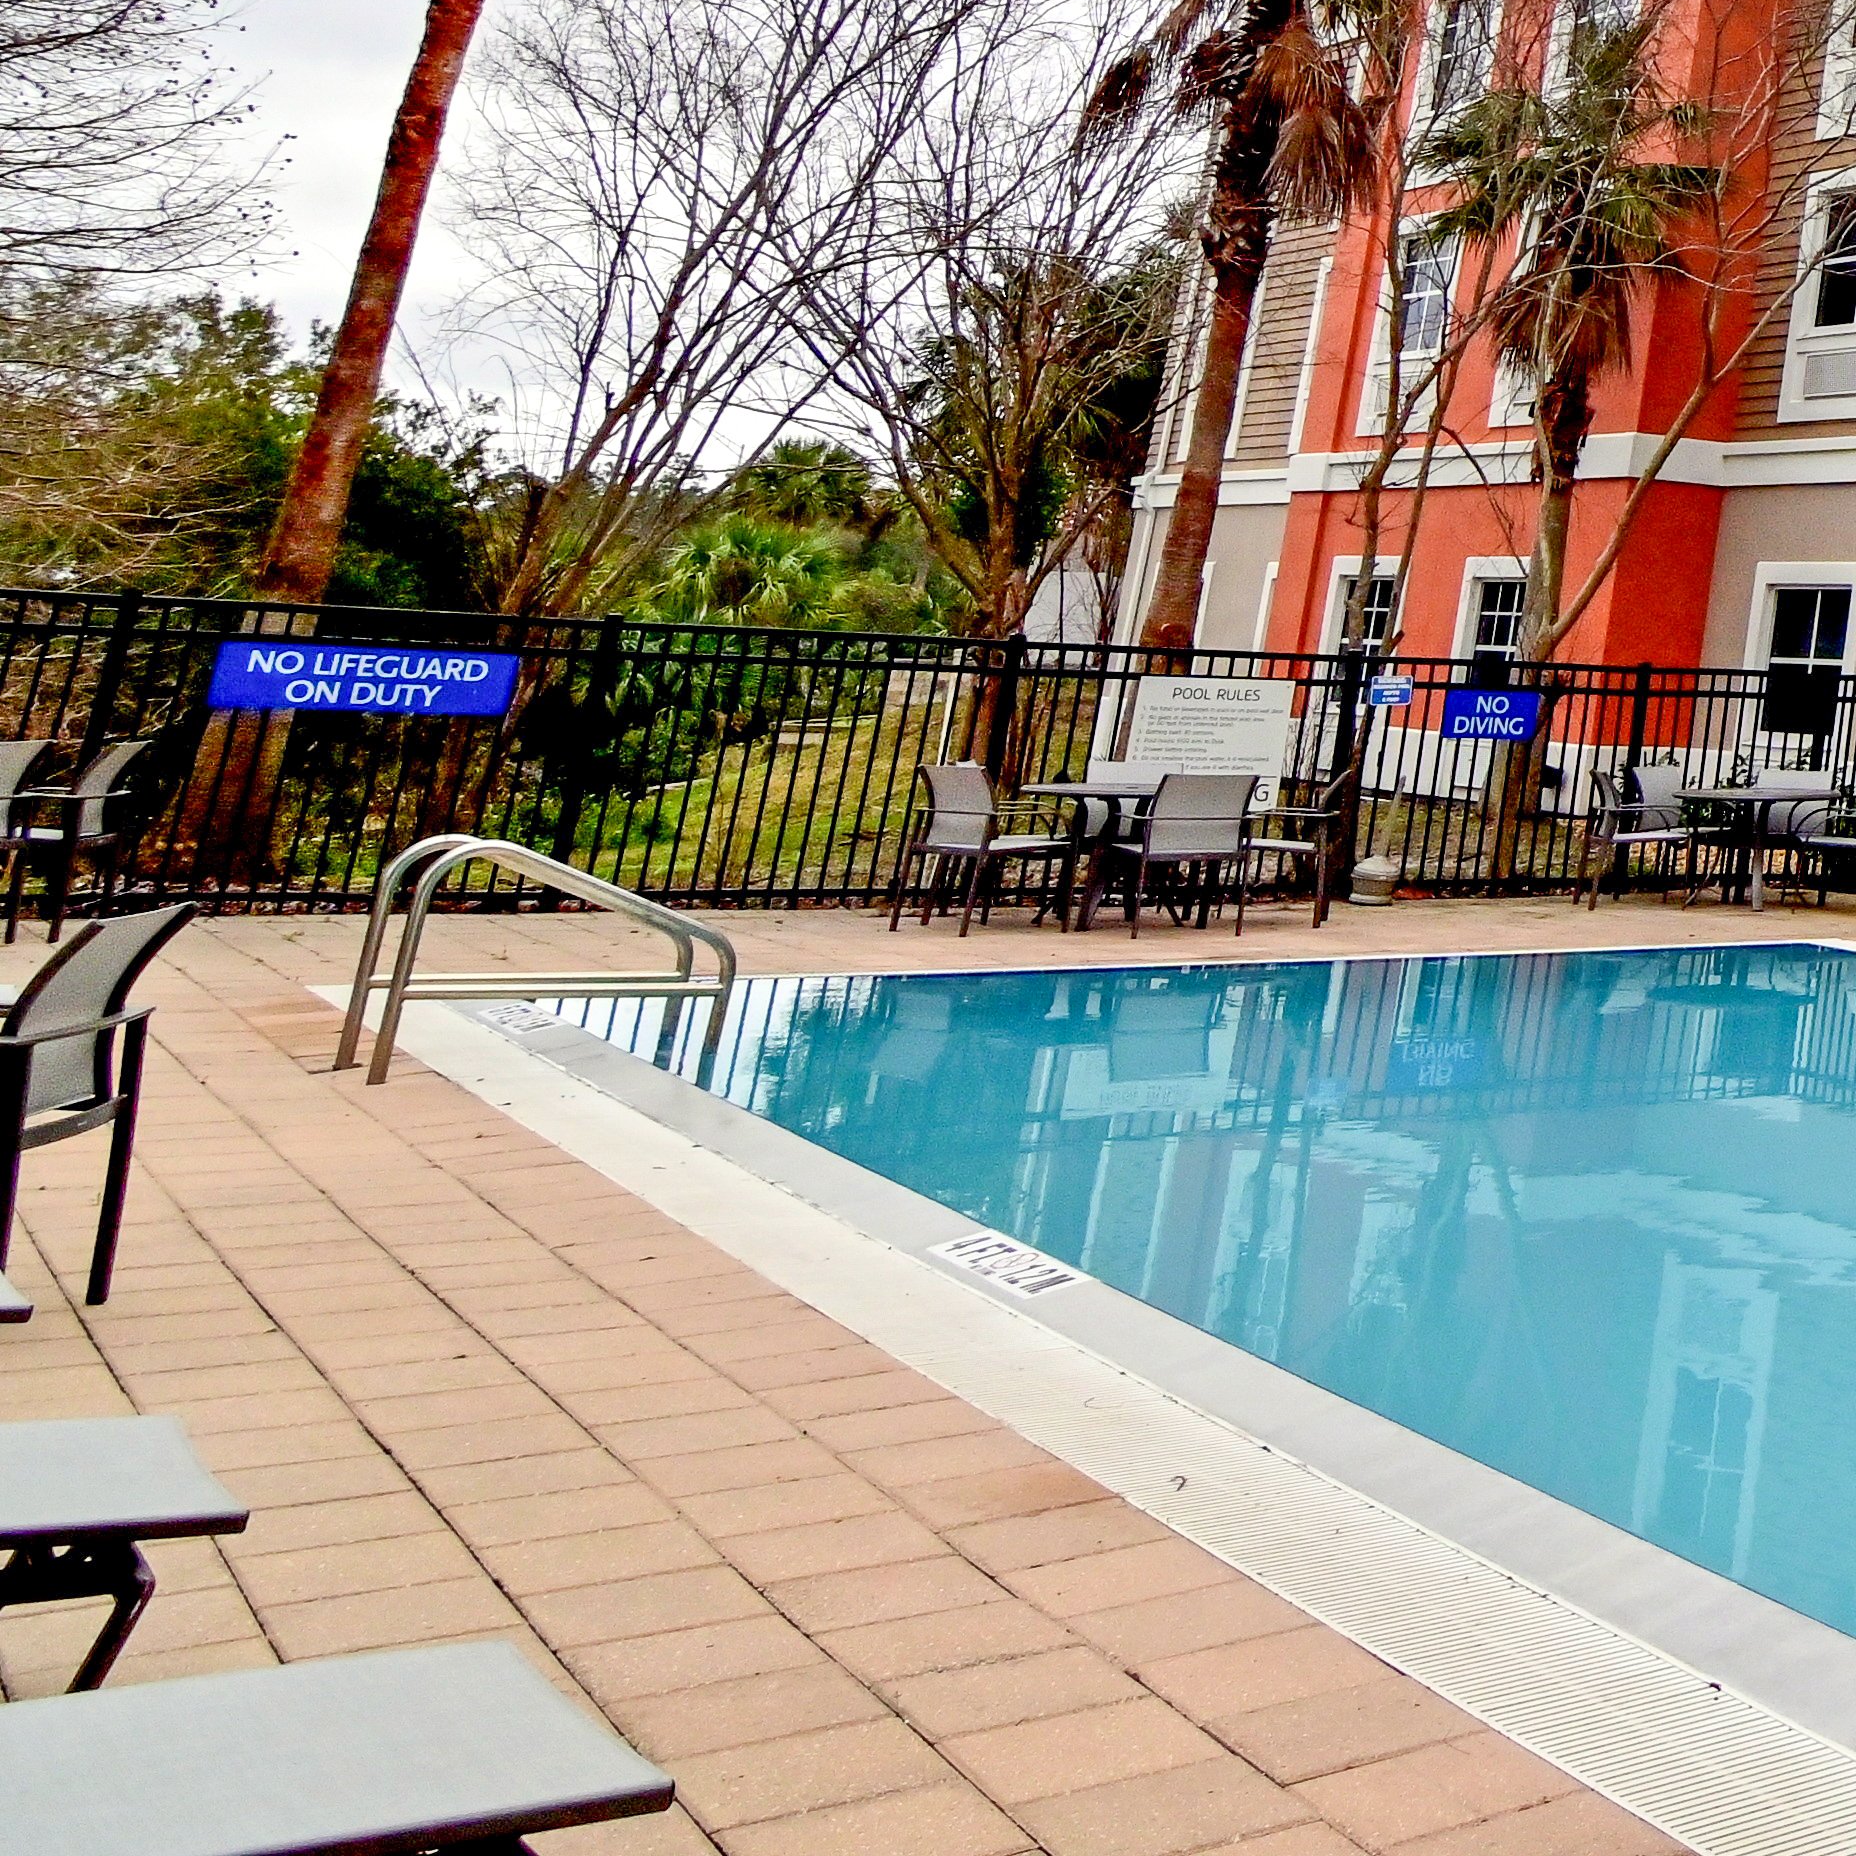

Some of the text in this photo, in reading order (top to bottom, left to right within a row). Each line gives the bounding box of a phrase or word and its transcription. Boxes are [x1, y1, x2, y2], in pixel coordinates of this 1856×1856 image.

[247, 649, 489, 682] NO LIFEGUARD
[285, 680, 443, 707] ON DUTY
[1172, 687, 1261, 702] POOL RULES
[1476, 696, 1510, 714] NO
[1453, 716, 1524, 735] DIVING
[945, 1236, 992, 1252] 4
